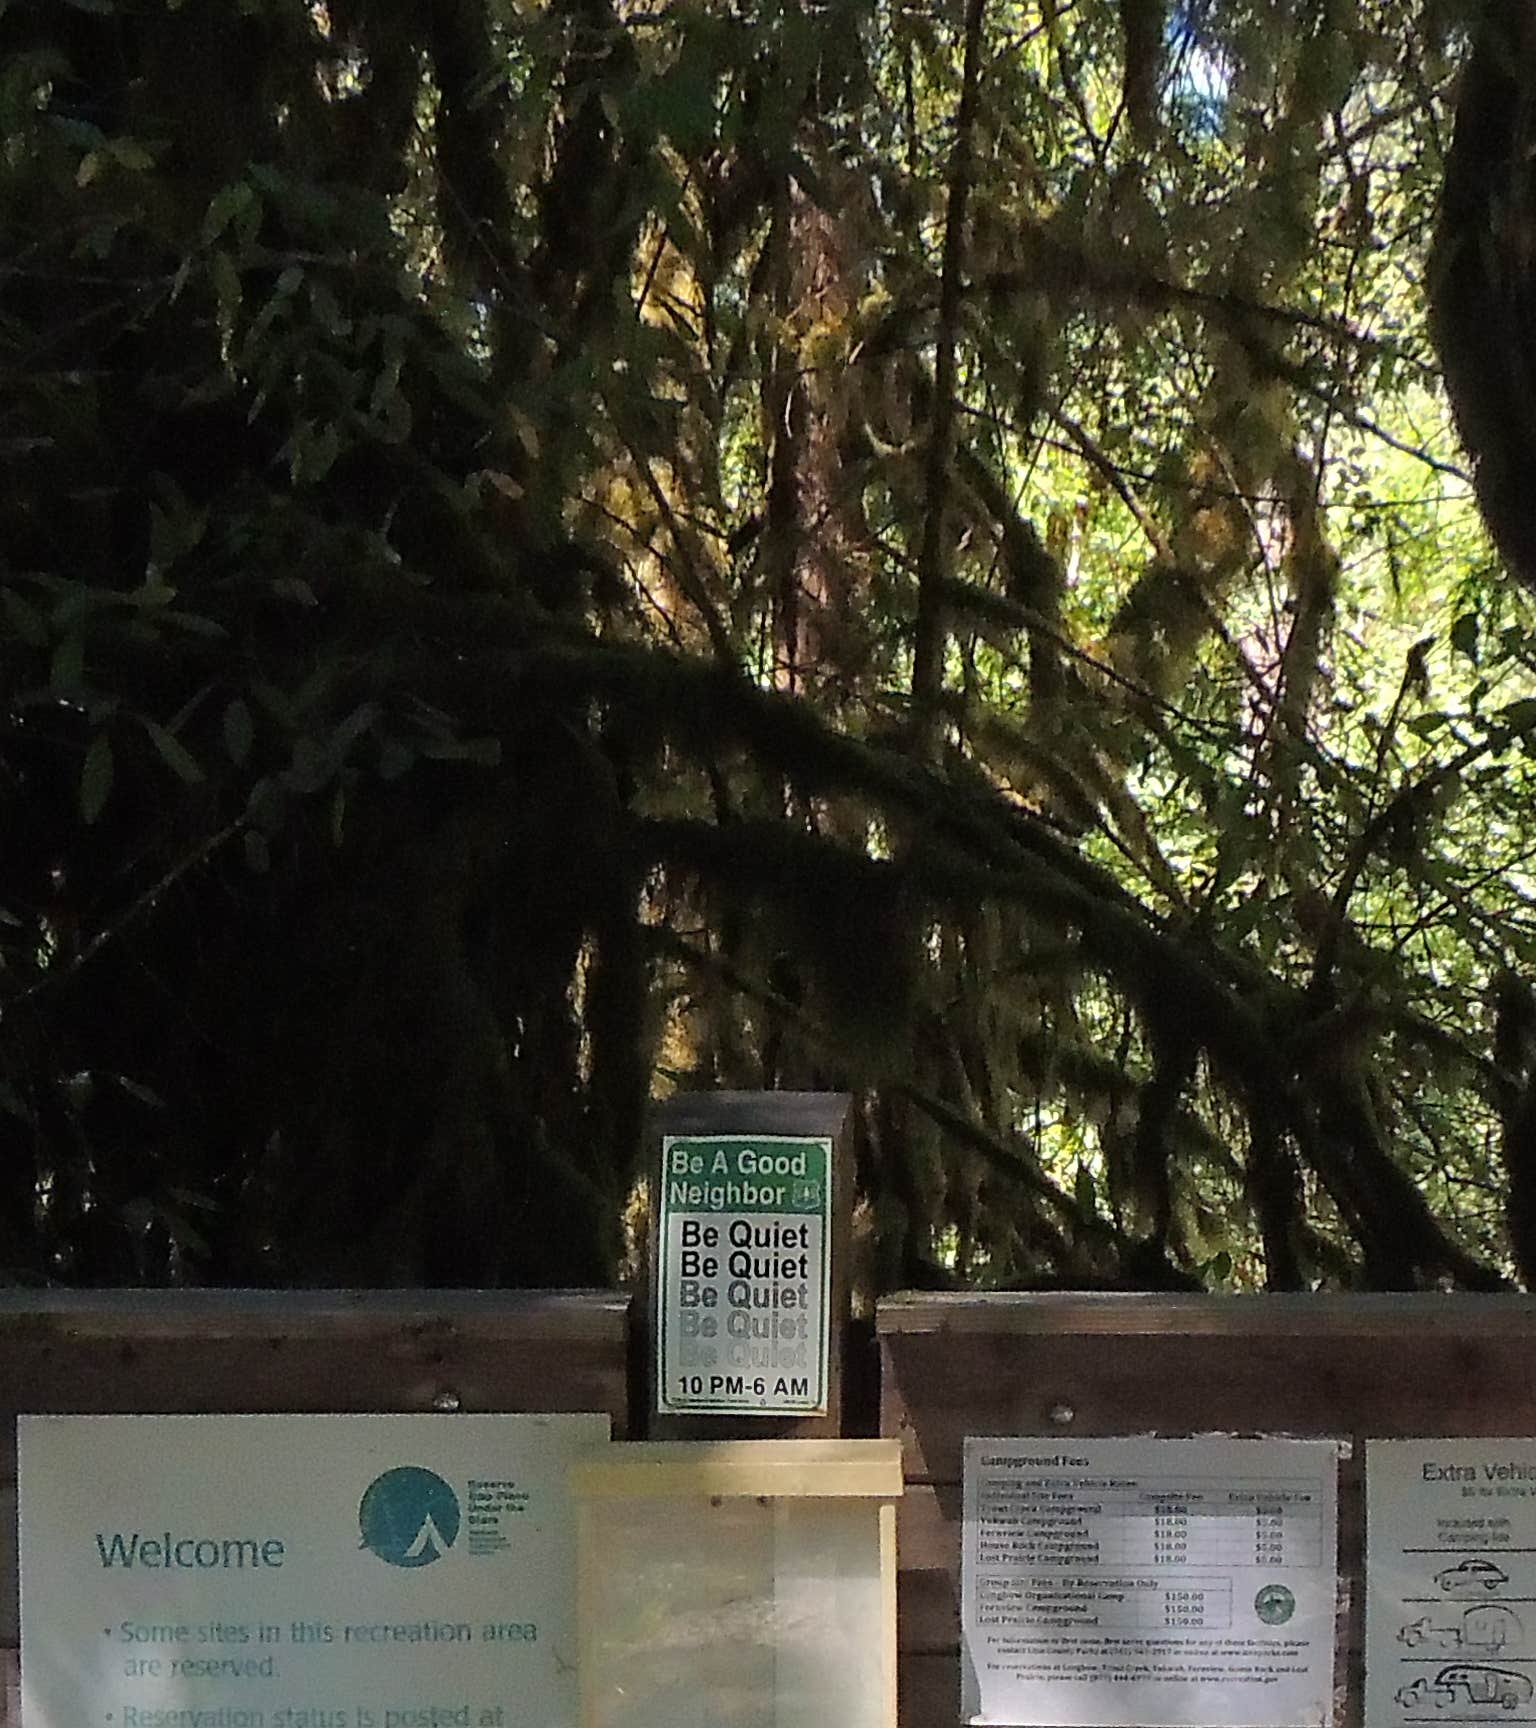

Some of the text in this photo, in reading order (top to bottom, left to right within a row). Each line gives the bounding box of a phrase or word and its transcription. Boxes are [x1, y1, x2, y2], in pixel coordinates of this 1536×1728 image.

[671, 1151, 806, 1175] Be A Good
[670, 1182, 785, 1209] Neighbor
[682, 1220, 808, 1250] Be Quiet
[681, 1250, 808, 1279] Be Quiet
[680, 1280, 808, 1309] Be Quiet
[680, 1311, 808, 1340] Be Quiet
[679, 1342, 808, 1370] Be Quiet
[678, 1376, 808, 1396] 10 PM-6 AM
[1423, 1463, 1476, 1482] Extra
[97, 1532, 286, 1569] Welcome
[120, 1621, 537, 1644] Some sites in this recreation area
[124, 1655, 280, 1678] are reserved.
[123, 1706, 264, 1728] Reservation
[356, 1707, 374, 1728] is
[479, 1708, 504, 1728] at
